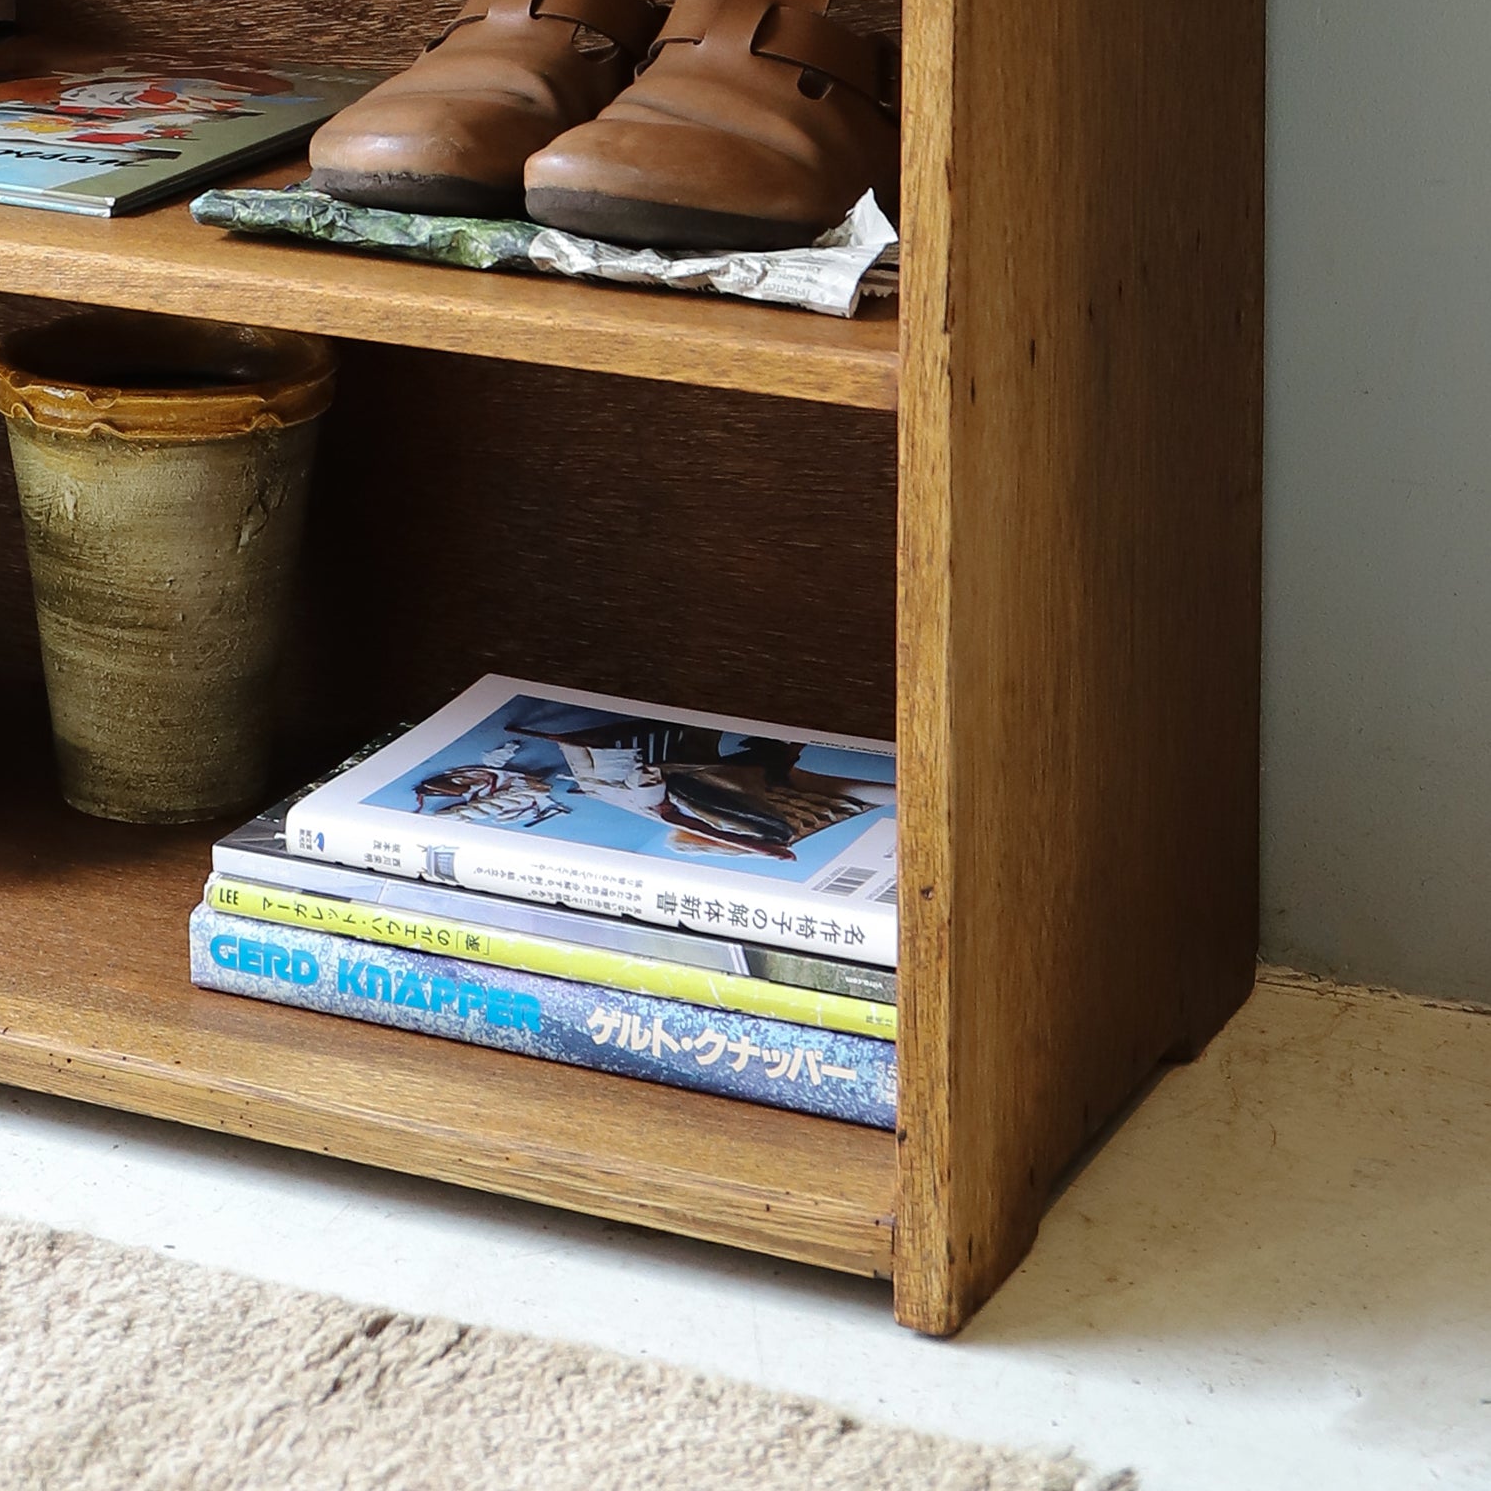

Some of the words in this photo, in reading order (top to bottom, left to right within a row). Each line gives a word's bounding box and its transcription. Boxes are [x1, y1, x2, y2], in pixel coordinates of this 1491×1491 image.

[219, 889, 239, 907] LEE
[261, 896, 491, 957] マーガレット・ハウエルの「家」
[655, 890, 866, 947] 名作椅子の解体新書
[209, 933, 320, 986] GERD
[337, 958, 543, 1033] KNÄPPER
[586, 1007, 858, 1087] ゲルト・クナッパー
